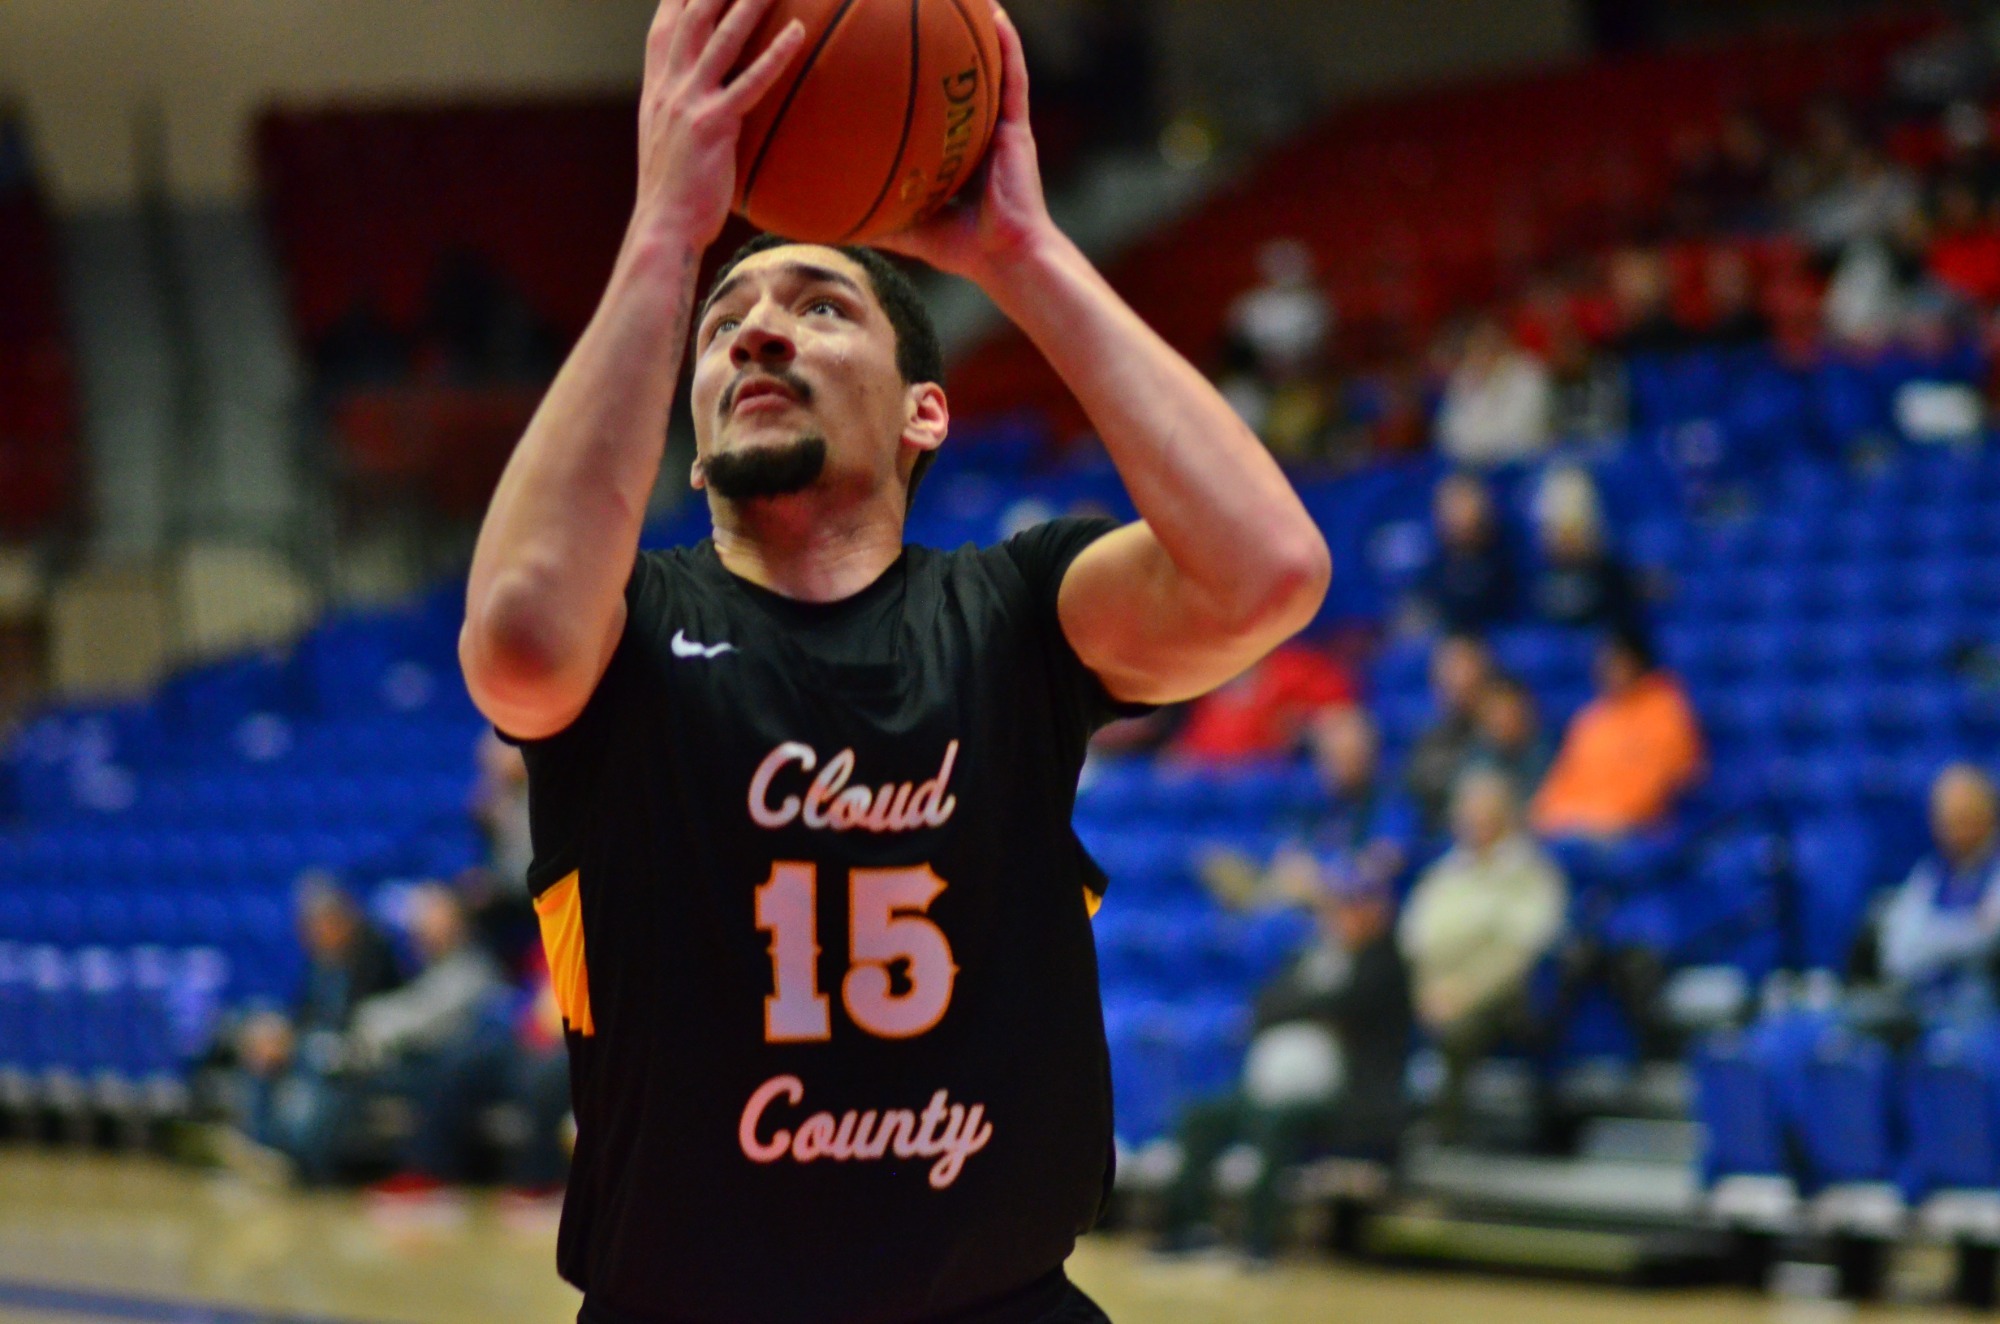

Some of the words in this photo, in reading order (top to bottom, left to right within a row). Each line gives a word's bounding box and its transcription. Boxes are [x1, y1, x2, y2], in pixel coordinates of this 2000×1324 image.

[748, 740, 958, 831] Cloud
[755, 861, 960, 1042] 15
[740, 1075, 993, 1188] County
